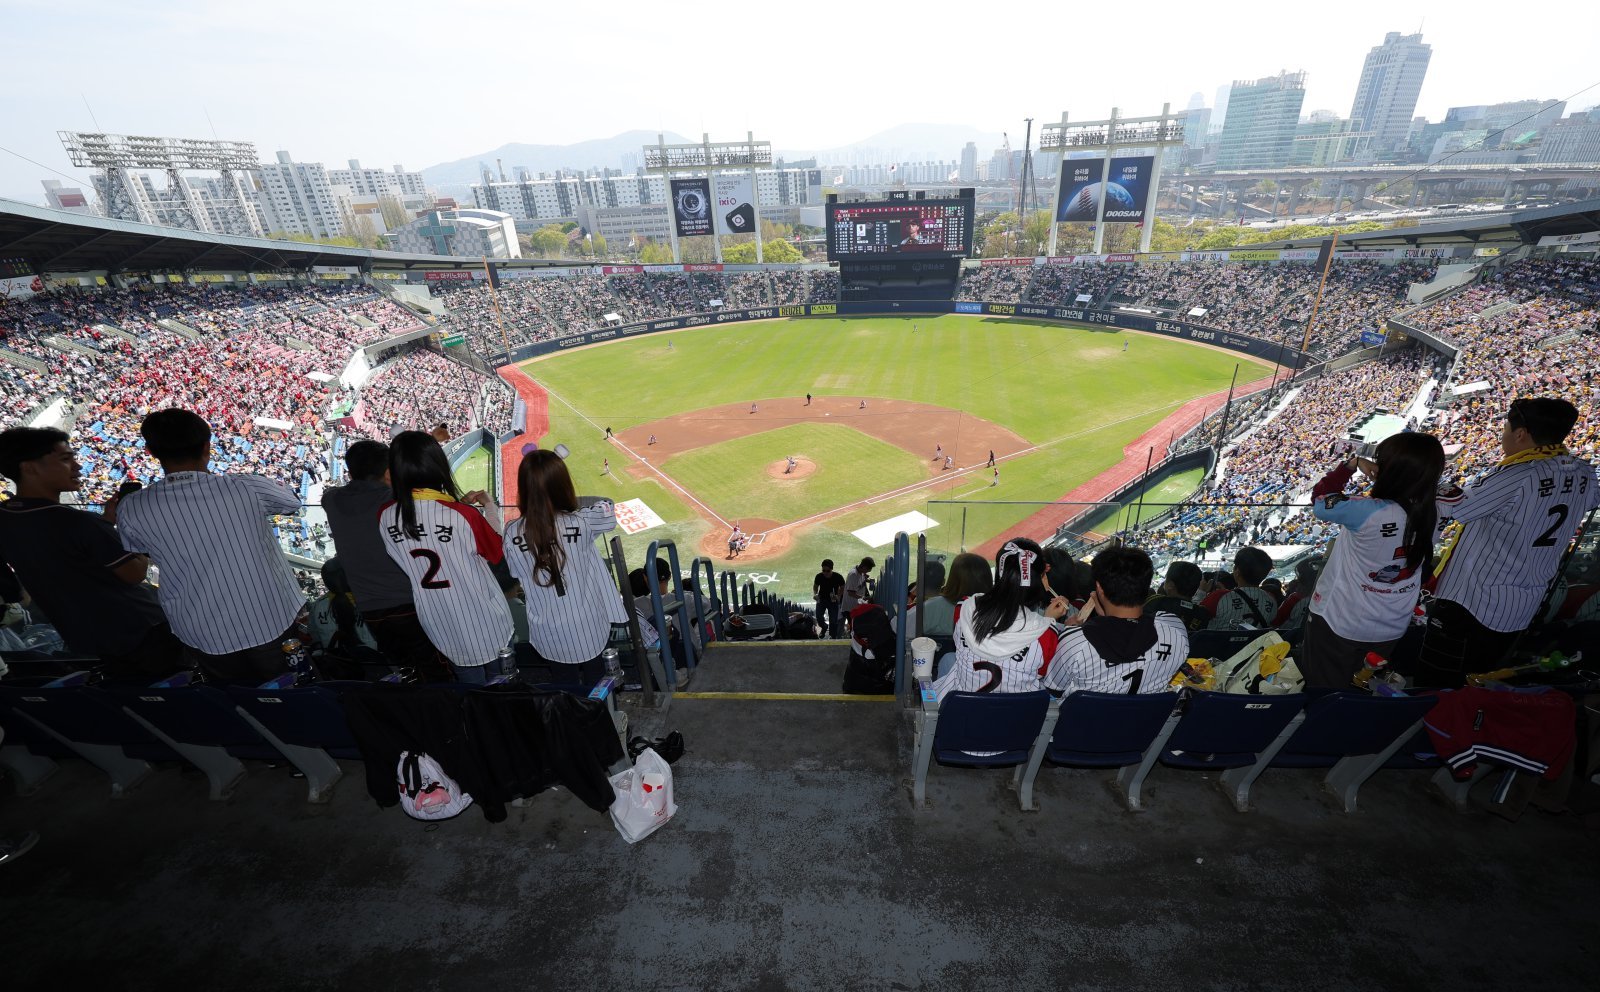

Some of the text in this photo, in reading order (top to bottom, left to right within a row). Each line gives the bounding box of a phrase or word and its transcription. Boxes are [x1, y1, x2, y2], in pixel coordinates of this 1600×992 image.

[781, 306, 803, 316] REUZEL
[988, 304, 1015, 315] 대방건설
[1538, 475, 1589, 498] 문보경
[1532, 503, 1569, 547] 2
[410, 548, 452, 590] 2
[746, 571, 781, 585] SOL
[1020, 553, 1029, 580] TWINS
